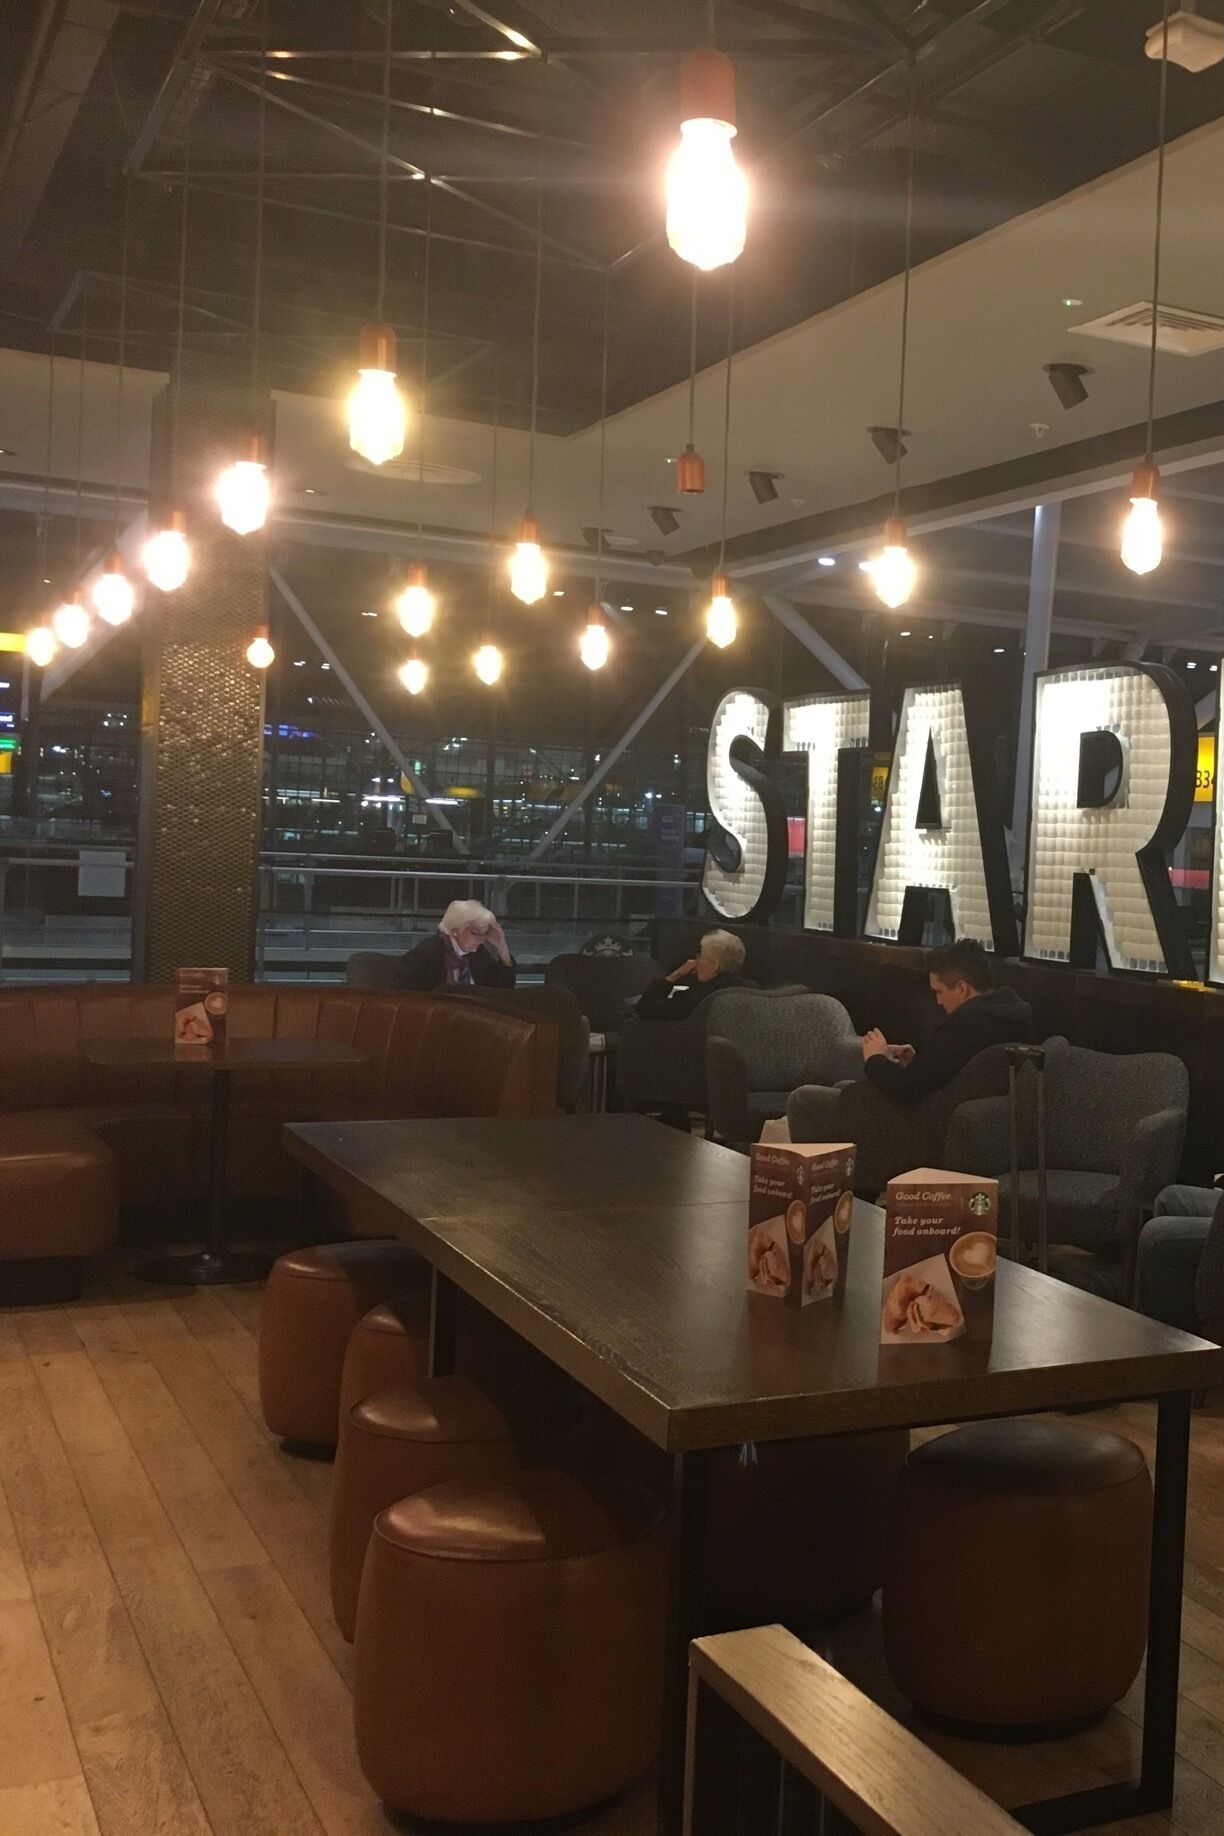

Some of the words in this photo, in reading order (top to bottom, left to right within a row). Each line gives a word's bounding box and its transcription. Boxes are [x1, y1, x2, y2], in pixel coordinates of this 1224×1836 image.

[895, 1191, 920, 1201] Good
[921, 1191, 952, 1202] Coffee
[894, 1216, 918, 1225] Take
[919, 1217, 944, 1226] your
[892, 1227, 916, 1237] food
[916, 1226, 961, 1236] onboard!
